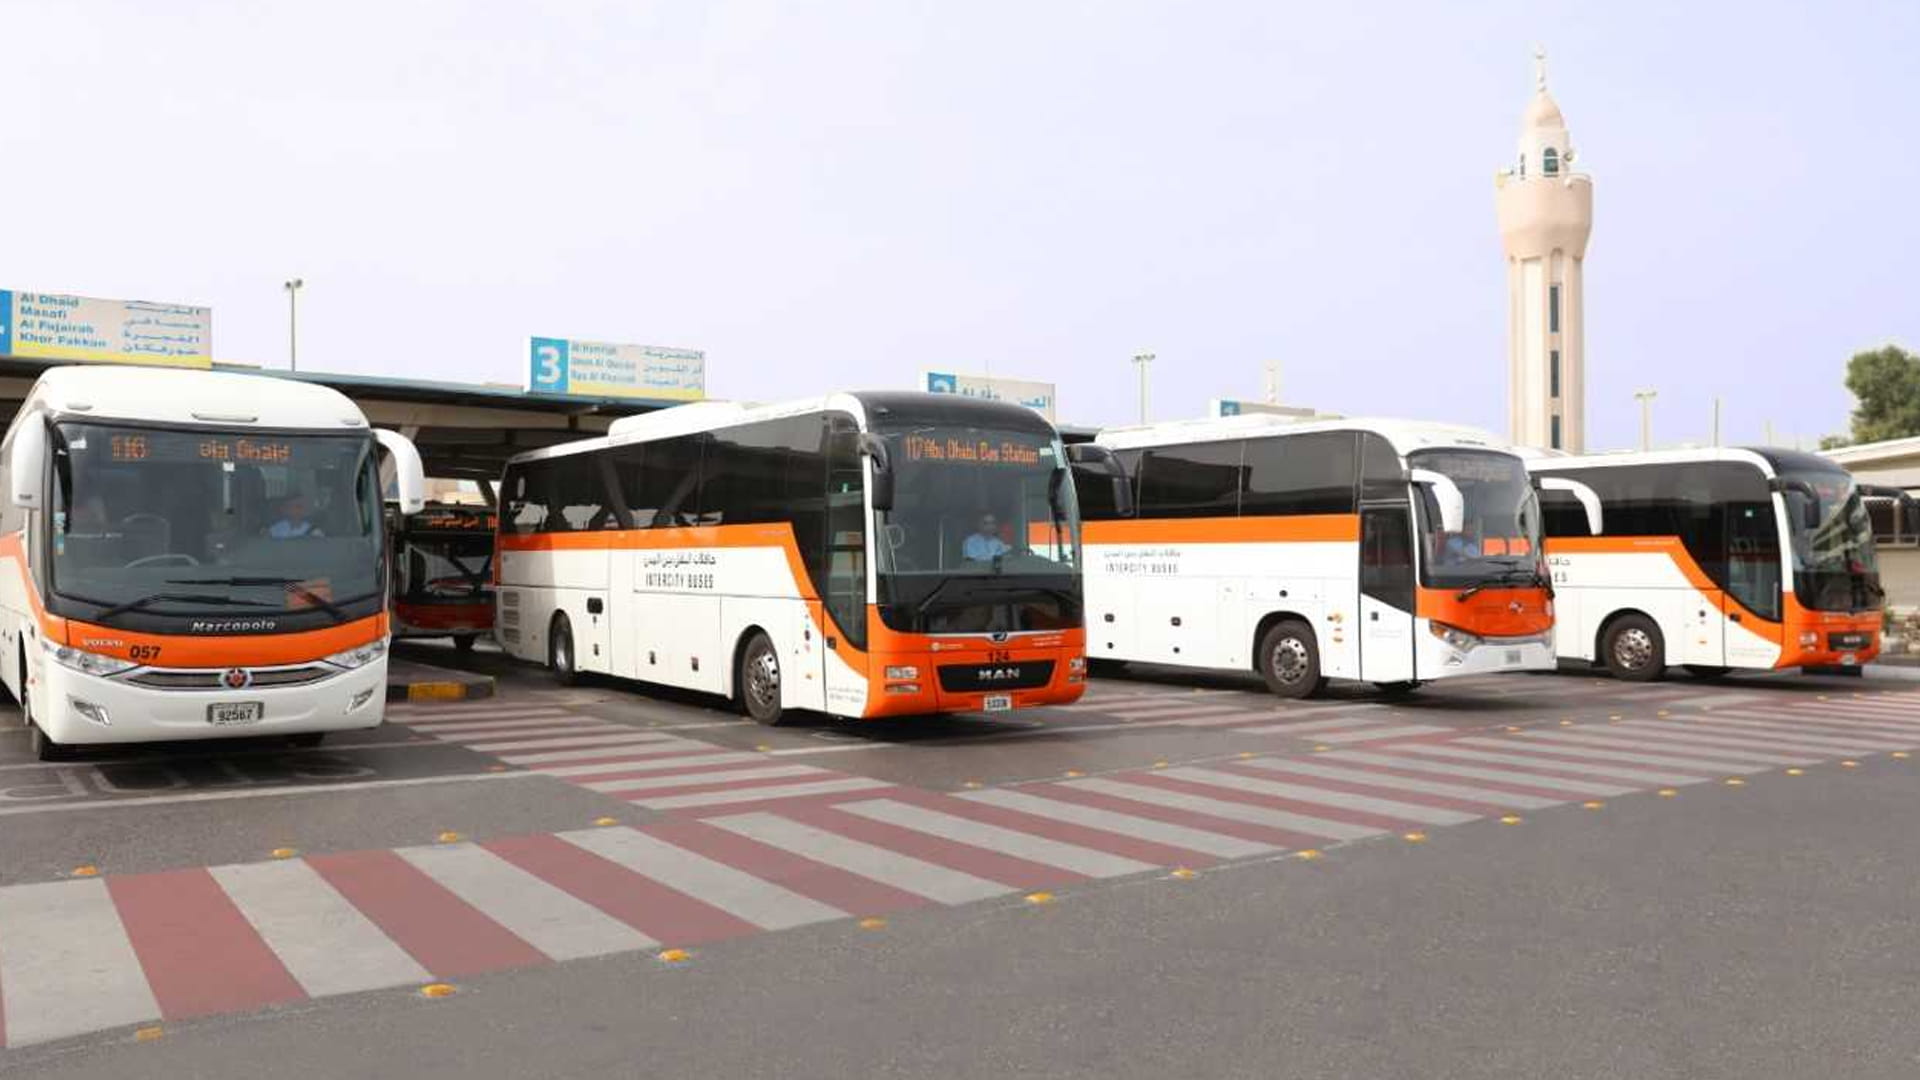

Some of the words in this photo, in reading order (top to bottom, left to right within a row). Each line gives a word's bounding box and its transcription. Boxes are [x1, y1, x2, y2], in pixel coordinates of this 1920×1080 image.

[20, 293, 35, 303] Al
[38, 295, 80, 307] Dhaid
[20, 319, 34, 330] Al
[536, 346, 561, 385] 3
[645, 572, 685, 588] INTERCITY
[688, 573, 714, 589] BUSES
[191, 620, 277, 632] Marcopolo
[129, 645, 161, 660] 057
[978, 667, 1021, 680] MAN
